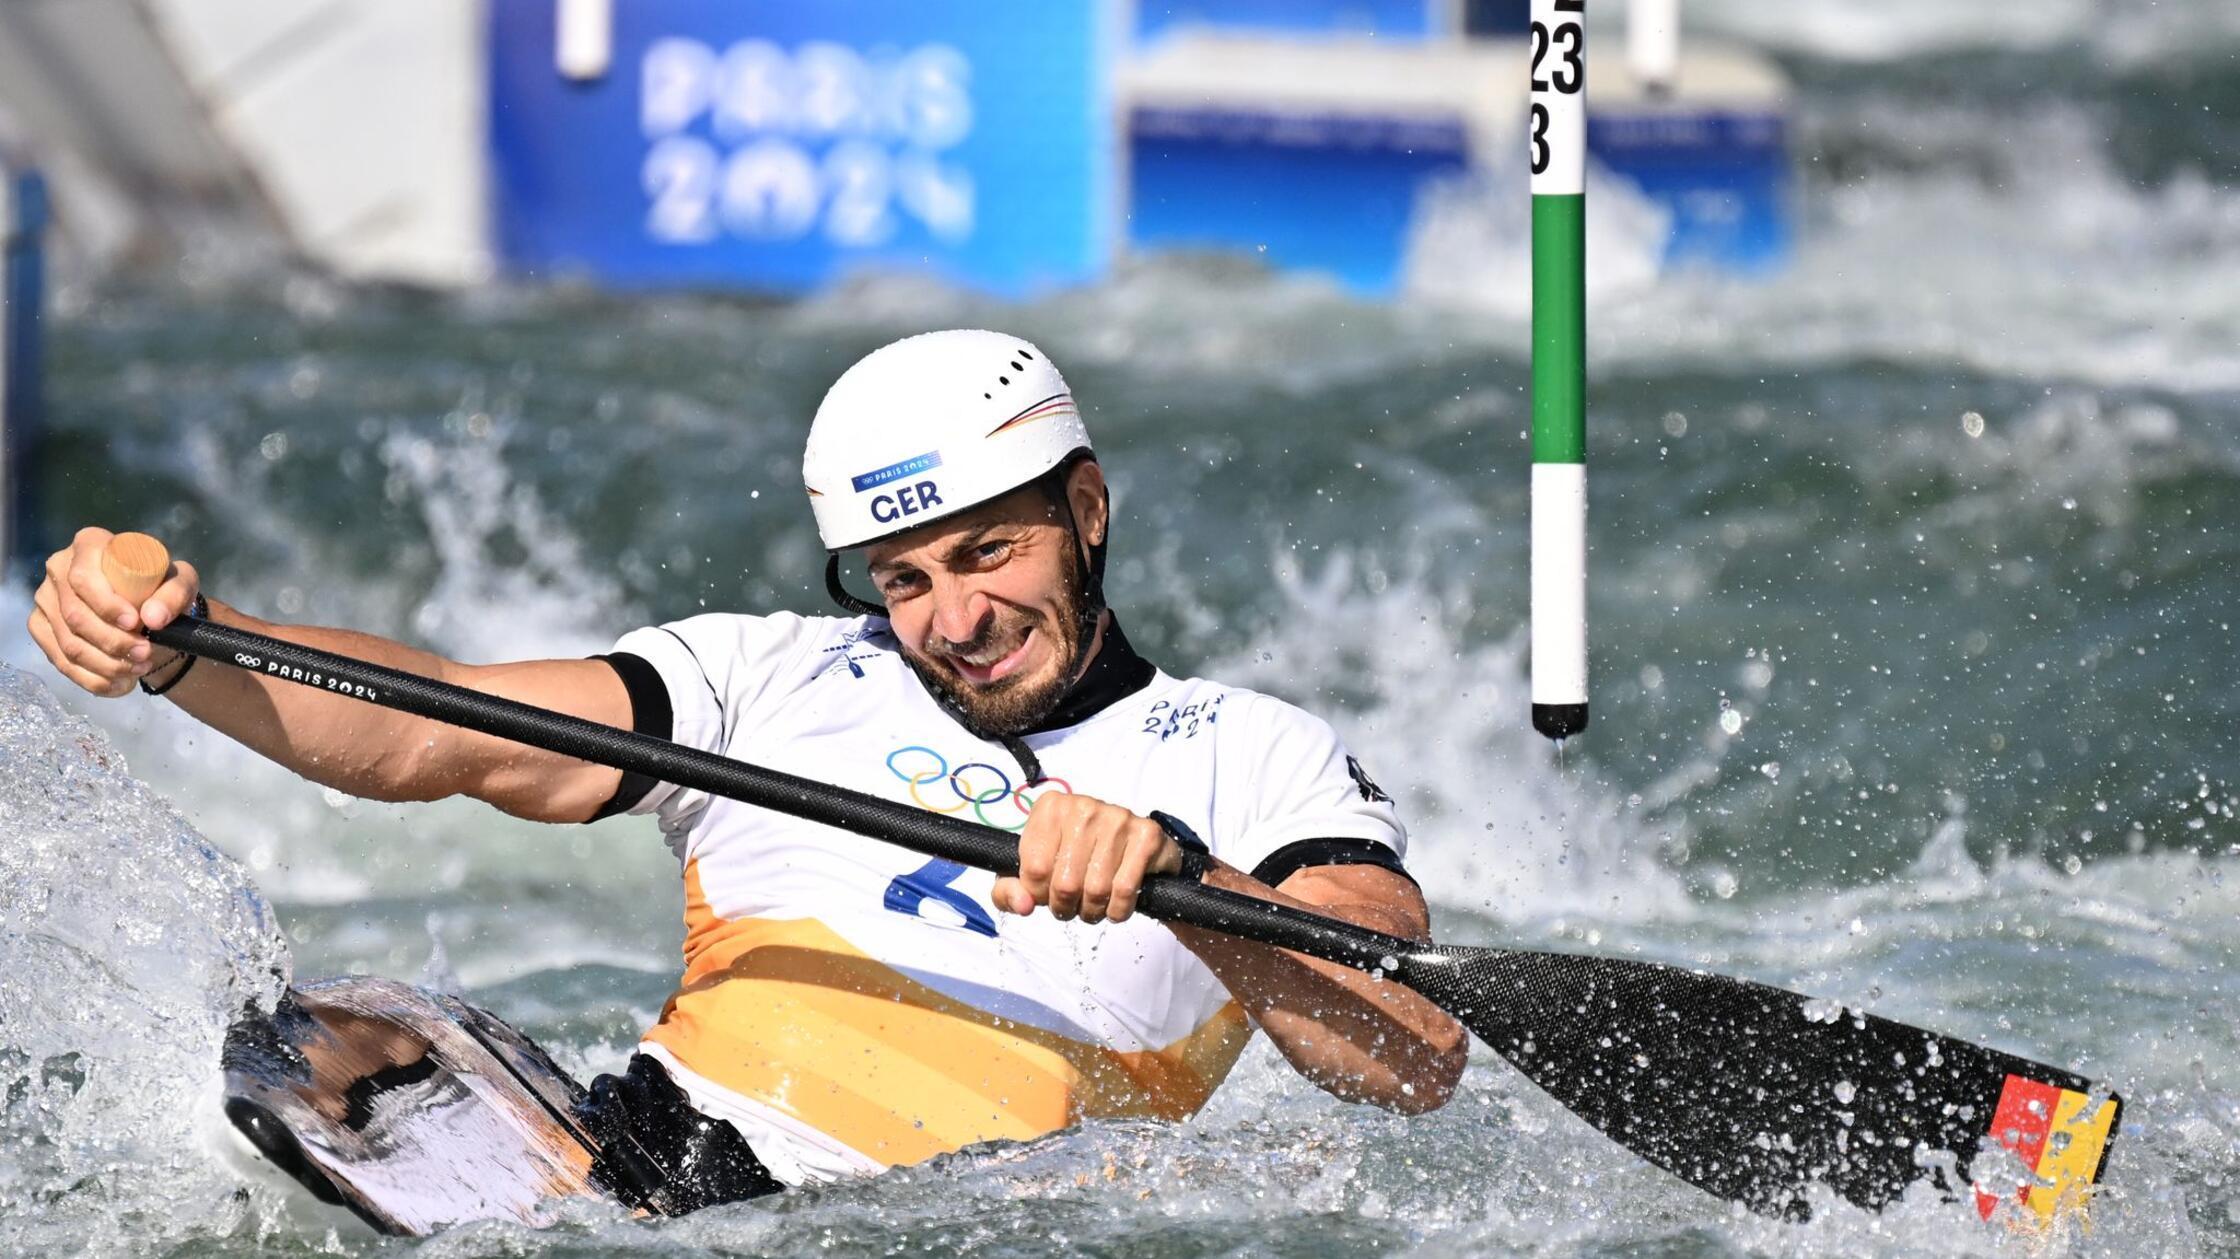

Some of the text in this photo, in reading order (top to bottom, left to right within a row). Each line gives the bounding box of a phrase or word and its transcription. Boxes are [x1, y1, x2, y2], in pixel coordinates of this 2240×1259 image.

[641, 38, 972, 148] PARIS
[875, 458, 930, 481] PARIS 2024
[871, 480, 943, 523] GER
[268, 662, 376, 701] PARIS 2024
